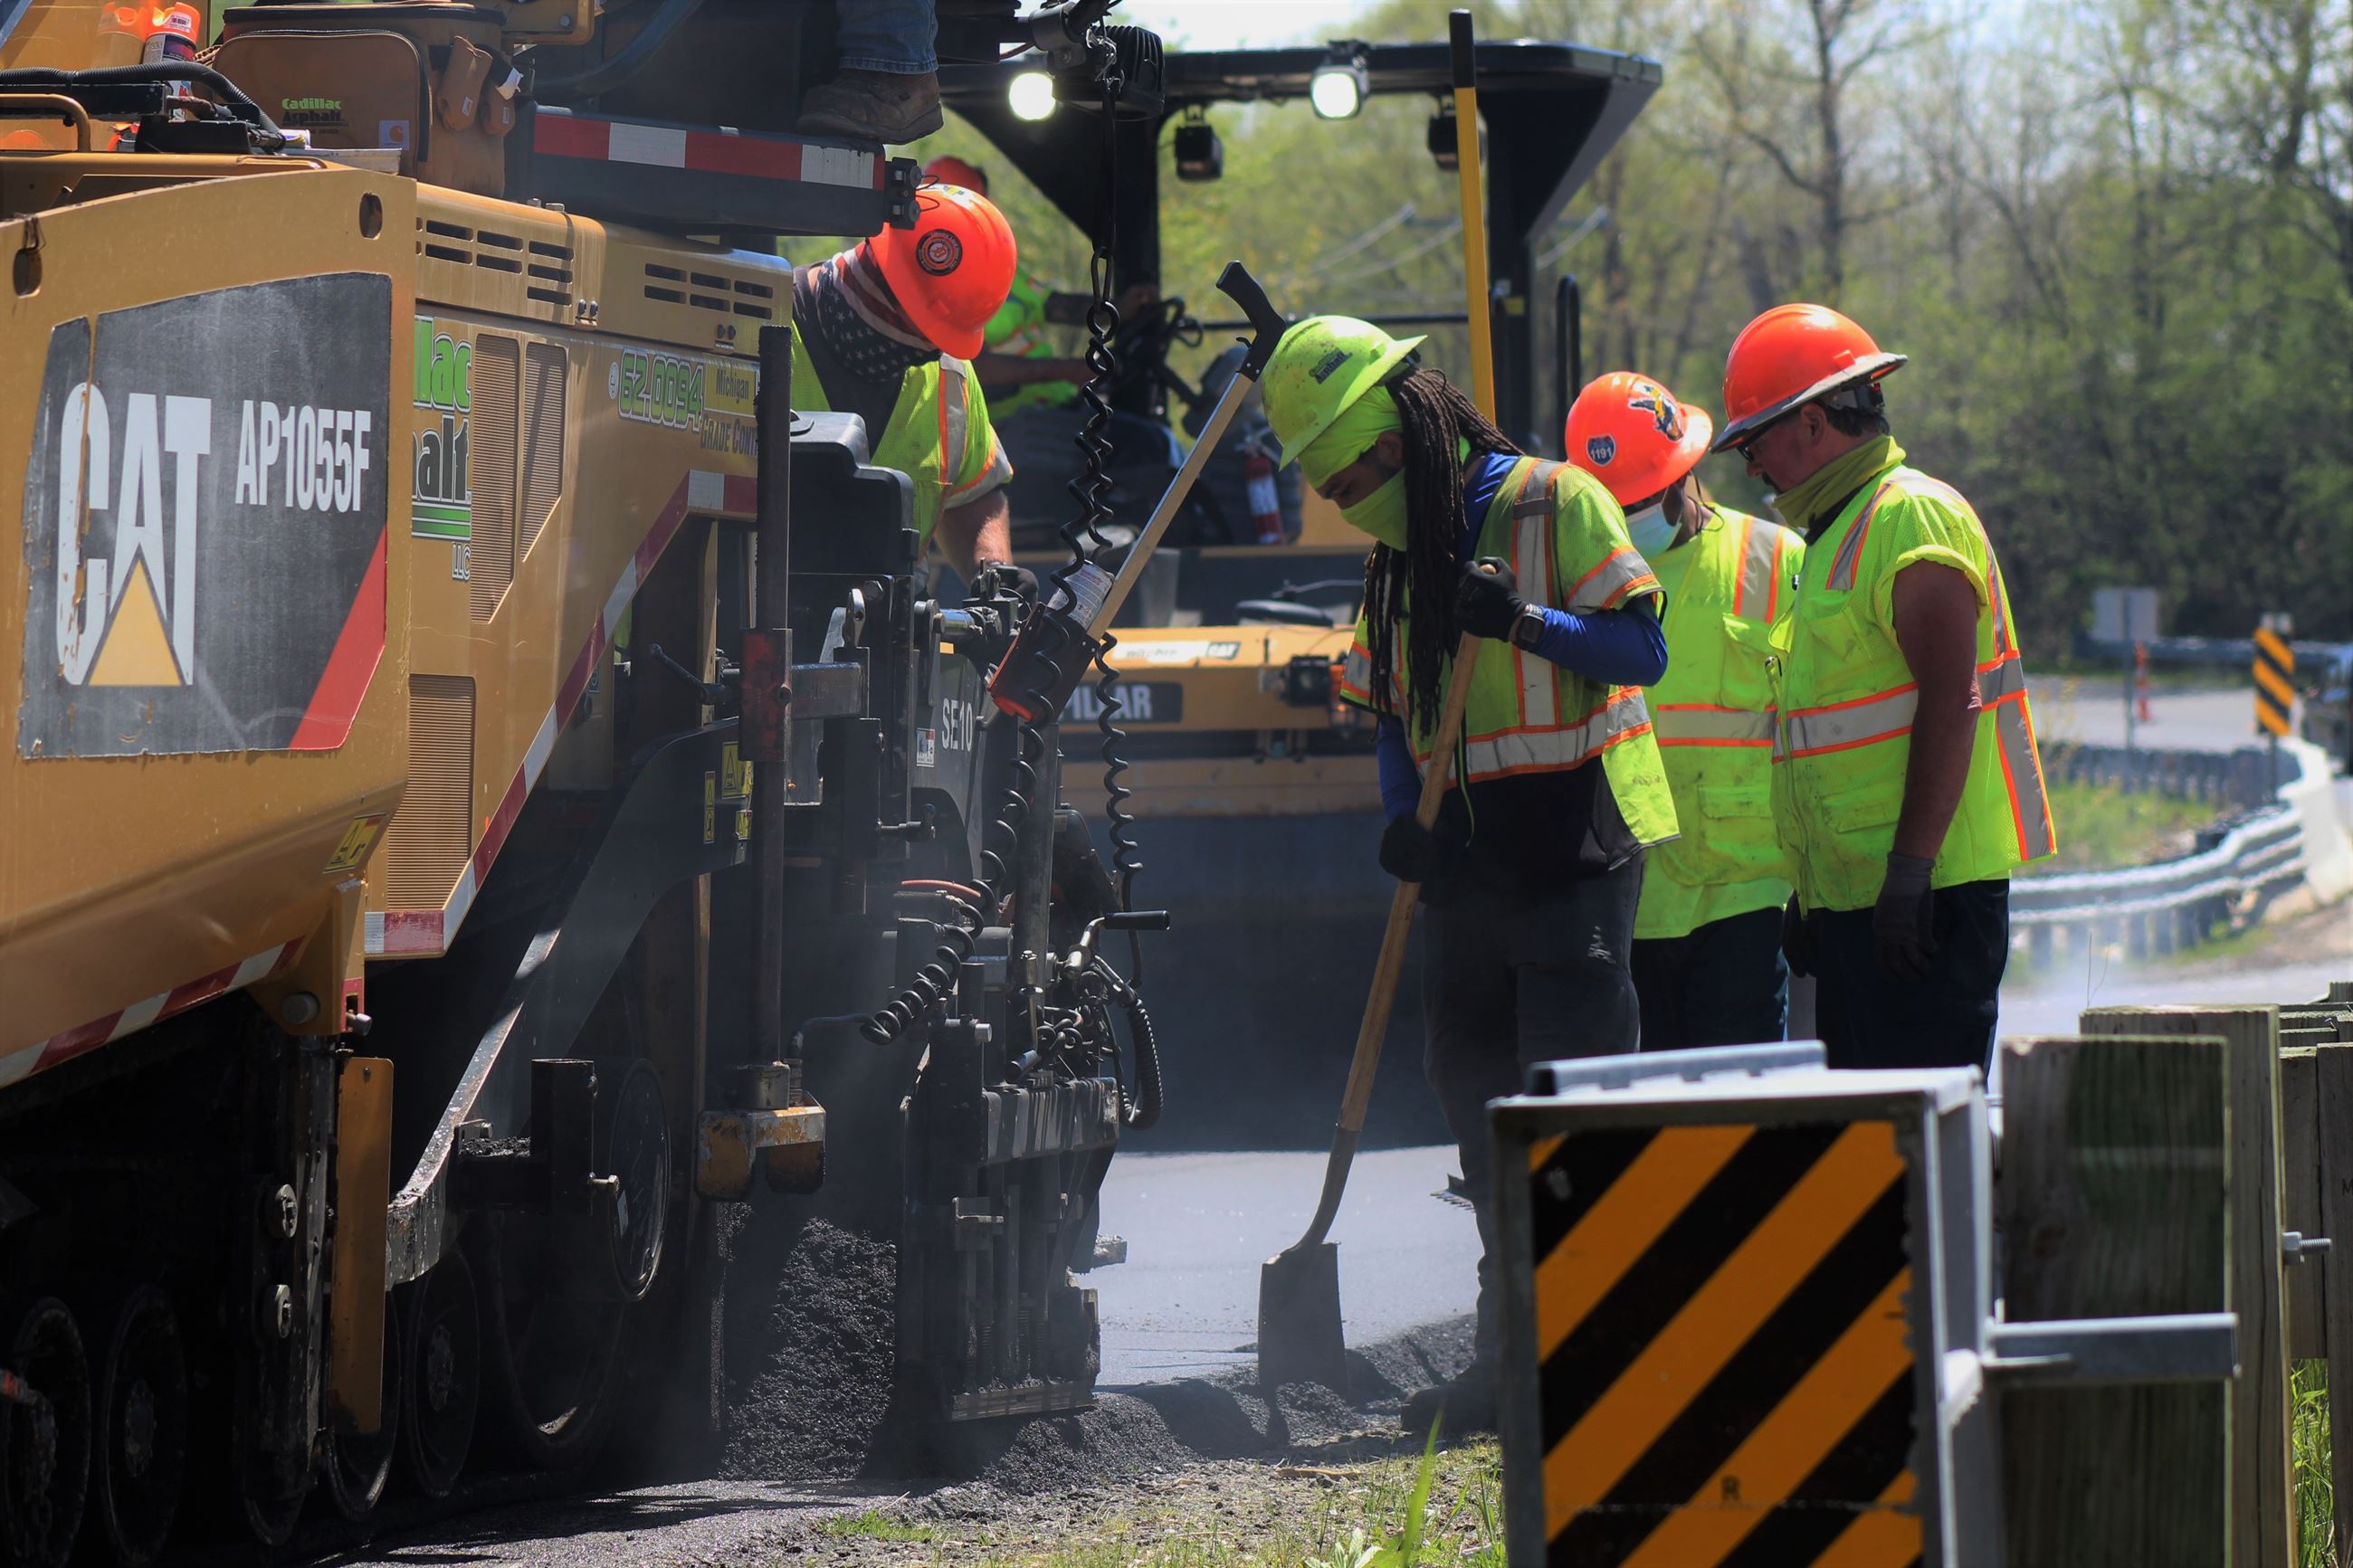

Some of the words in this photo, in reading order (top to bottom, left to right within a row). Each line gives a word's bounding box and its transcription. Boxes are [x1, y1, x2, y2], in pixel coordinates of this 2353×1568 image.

[282, 99, 342, 109] Cadillac
[619, 347, 704, 432] 62.0094
[716, 368, 749, 404] Michigan
[1590, 446, 1612, 460] 1191
[56, 382, 212, 686] CAT
[235, 400, 372, 513] AP1055F
[452, 543, 471, 580] LLC
[942, 698, 973, 752] SE10
